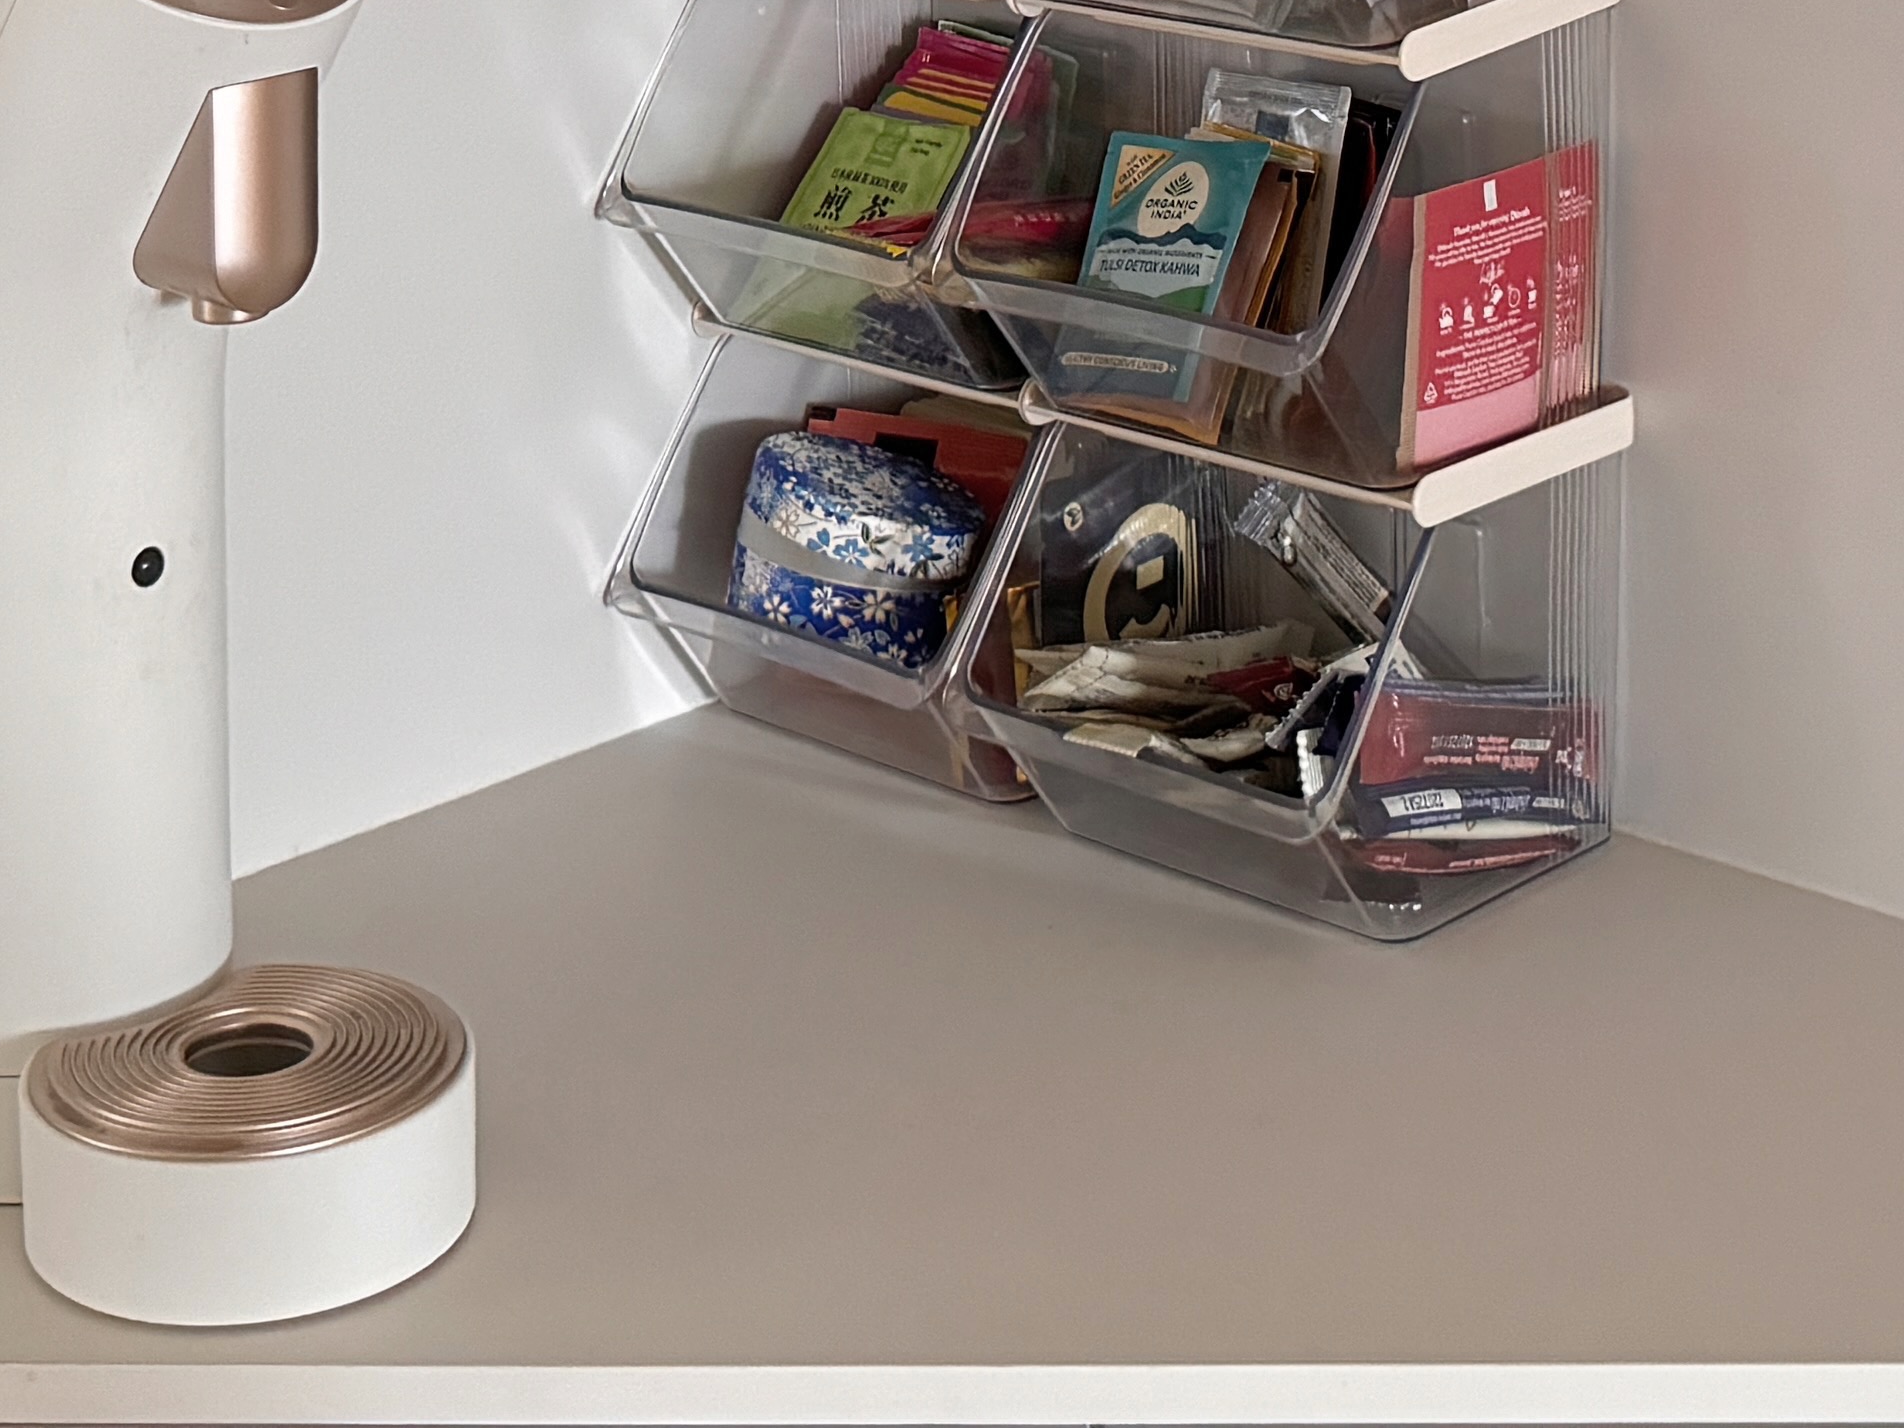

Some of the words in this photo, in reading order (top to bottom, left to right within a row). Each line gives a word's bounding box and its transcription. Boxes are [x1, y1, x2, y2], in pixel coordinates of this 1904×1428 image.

[1145, 198, 1198, 210] ORGANIC
[1099, 258, 1124, 273] TULSI
[1124, 259, 1158, 273] DETOX
[1159, 261, 1201, 277] KAHWA
